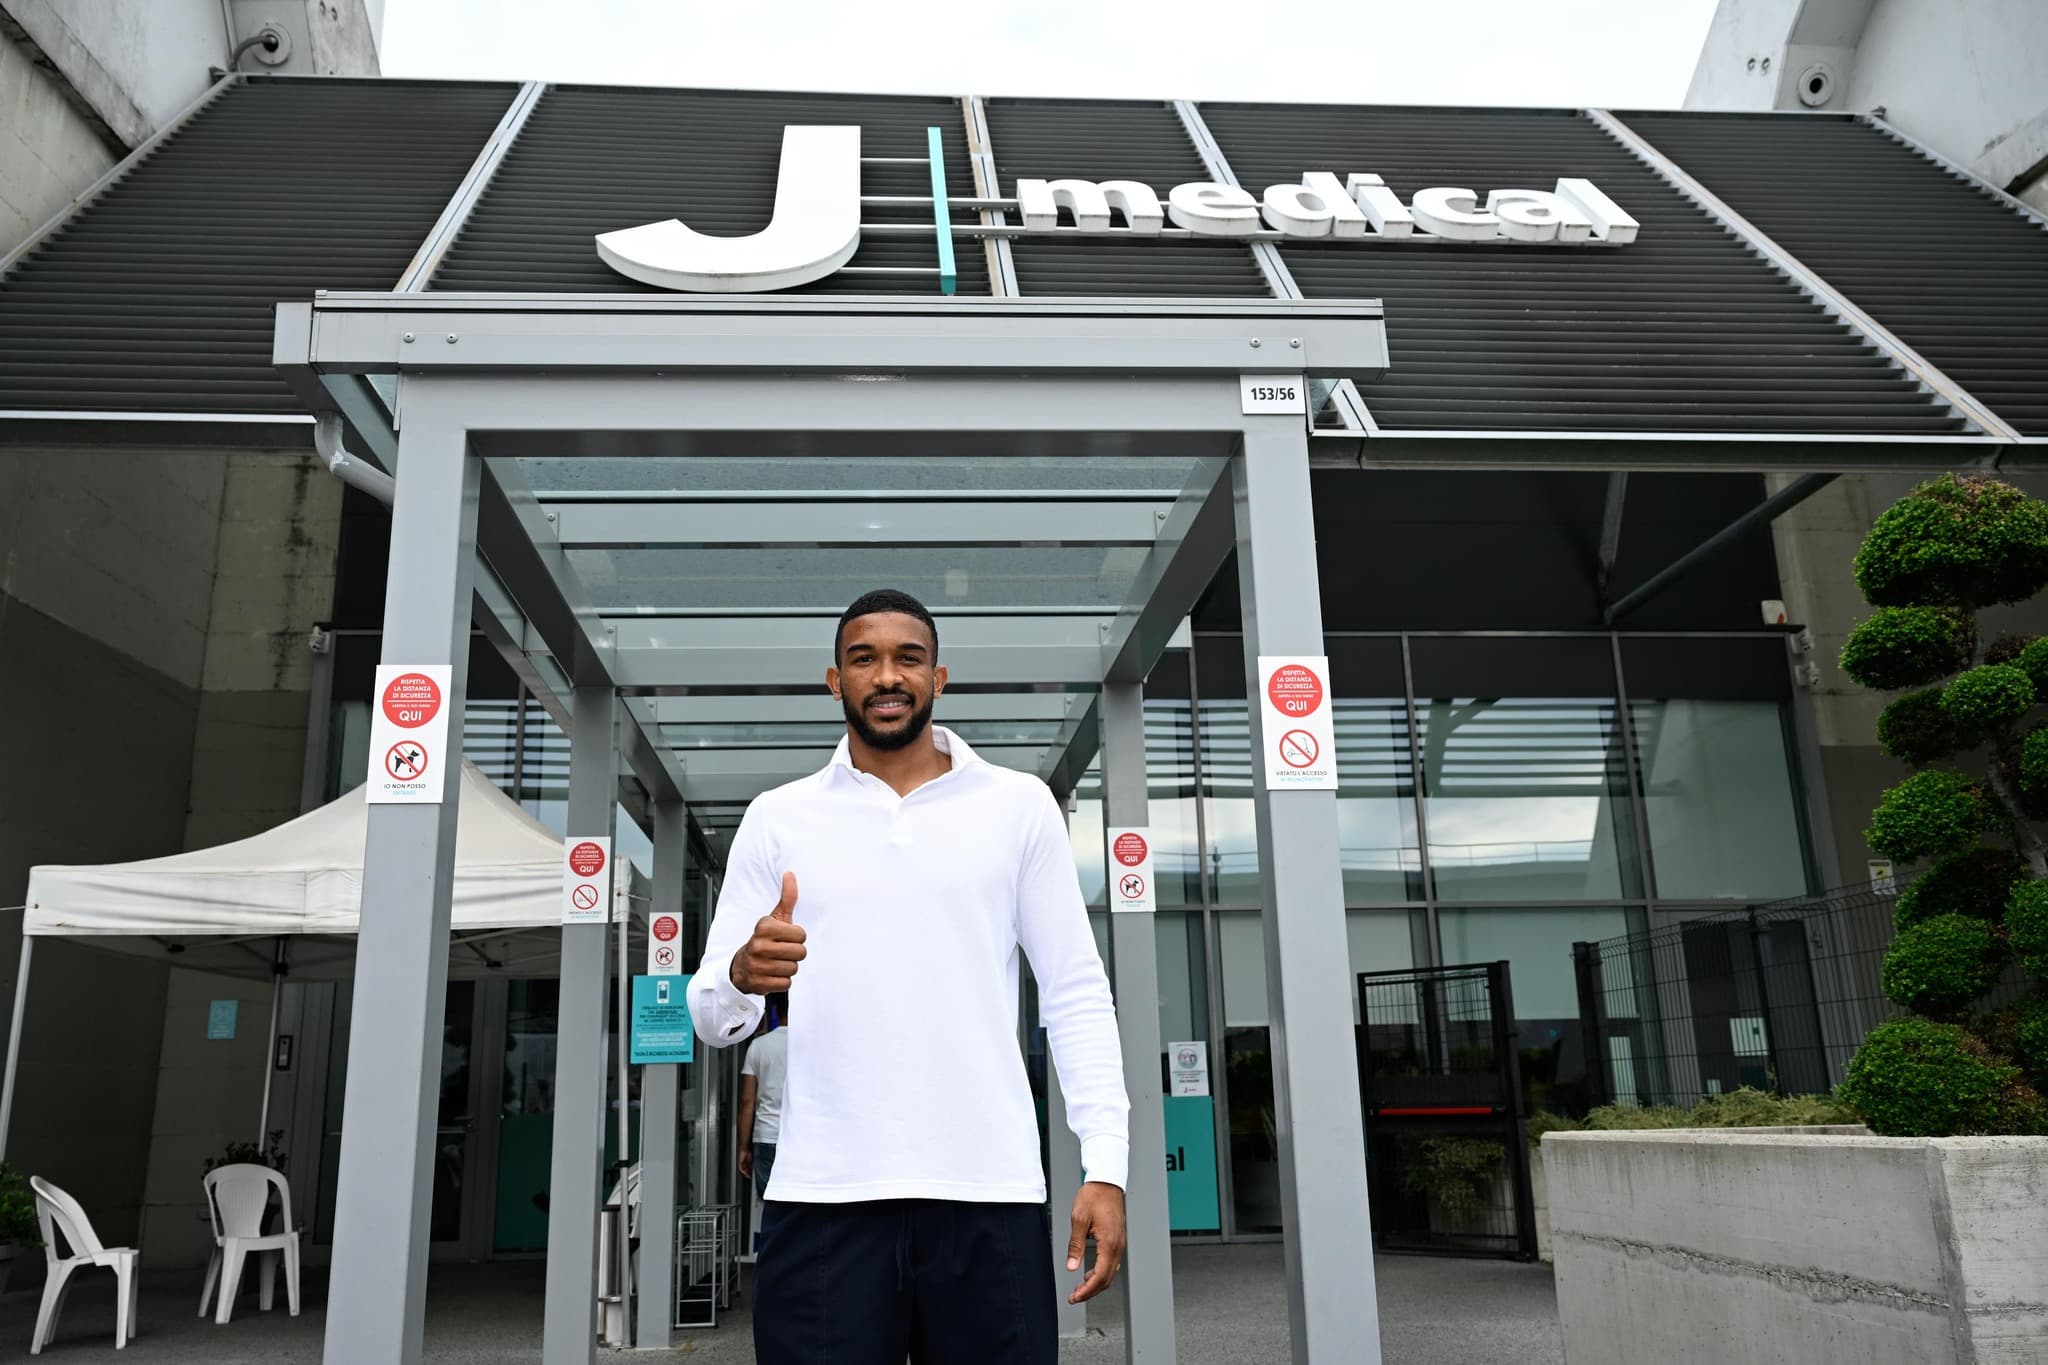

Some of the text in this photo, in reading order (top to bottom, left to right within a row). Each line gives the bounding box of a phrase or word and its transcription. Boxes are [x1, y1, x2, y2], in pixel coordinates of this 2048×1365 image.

[595, 125, 1640, 293] J medical
[1251, 387, 1295, 400] 153/56
[1286, 700, 1308, 711] QUI
[399, 710, 422, 721] QUI
[580, 865, 594, 873] QUI
